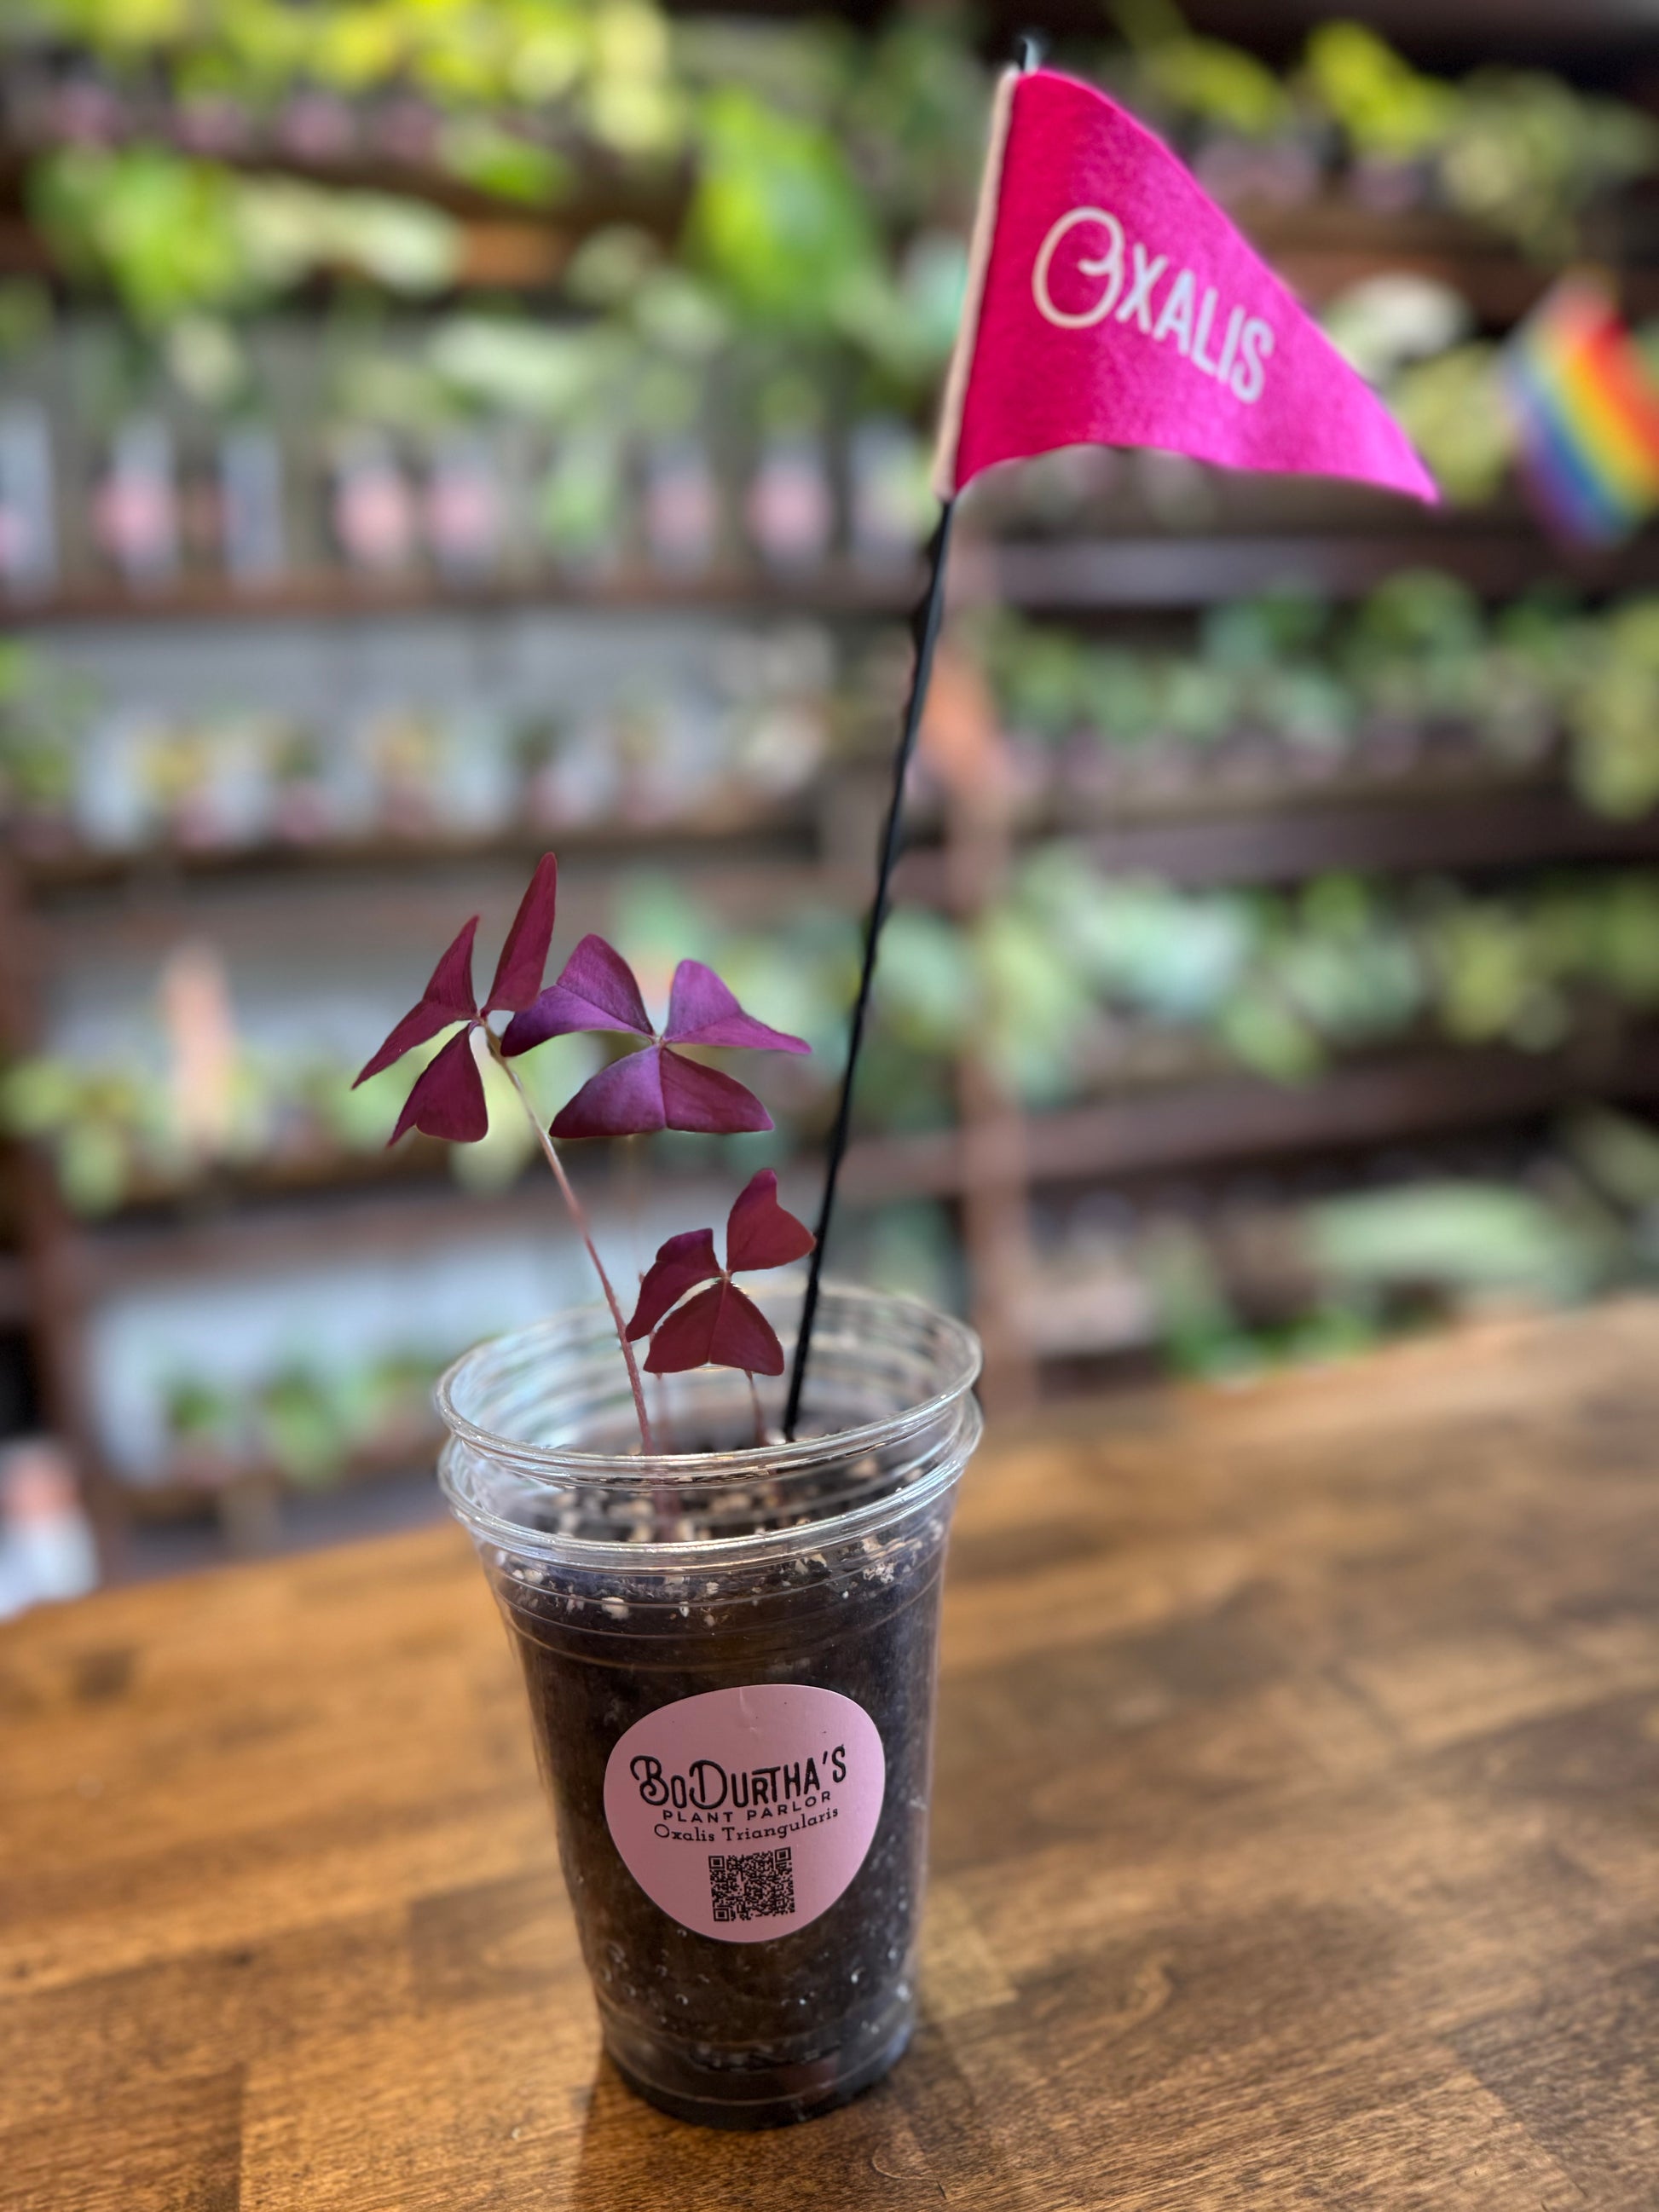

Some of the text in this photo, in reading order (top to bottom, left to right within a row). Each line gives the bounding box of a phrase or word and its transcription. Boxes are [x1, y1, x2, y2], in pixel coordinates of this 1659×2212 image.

[1032, 206, 1274, 402] OXALIS
[654, 1807, 839, 1842] Oxalis Triangularis
[662, 1791, 831, 1823] PLANT PARLOR
